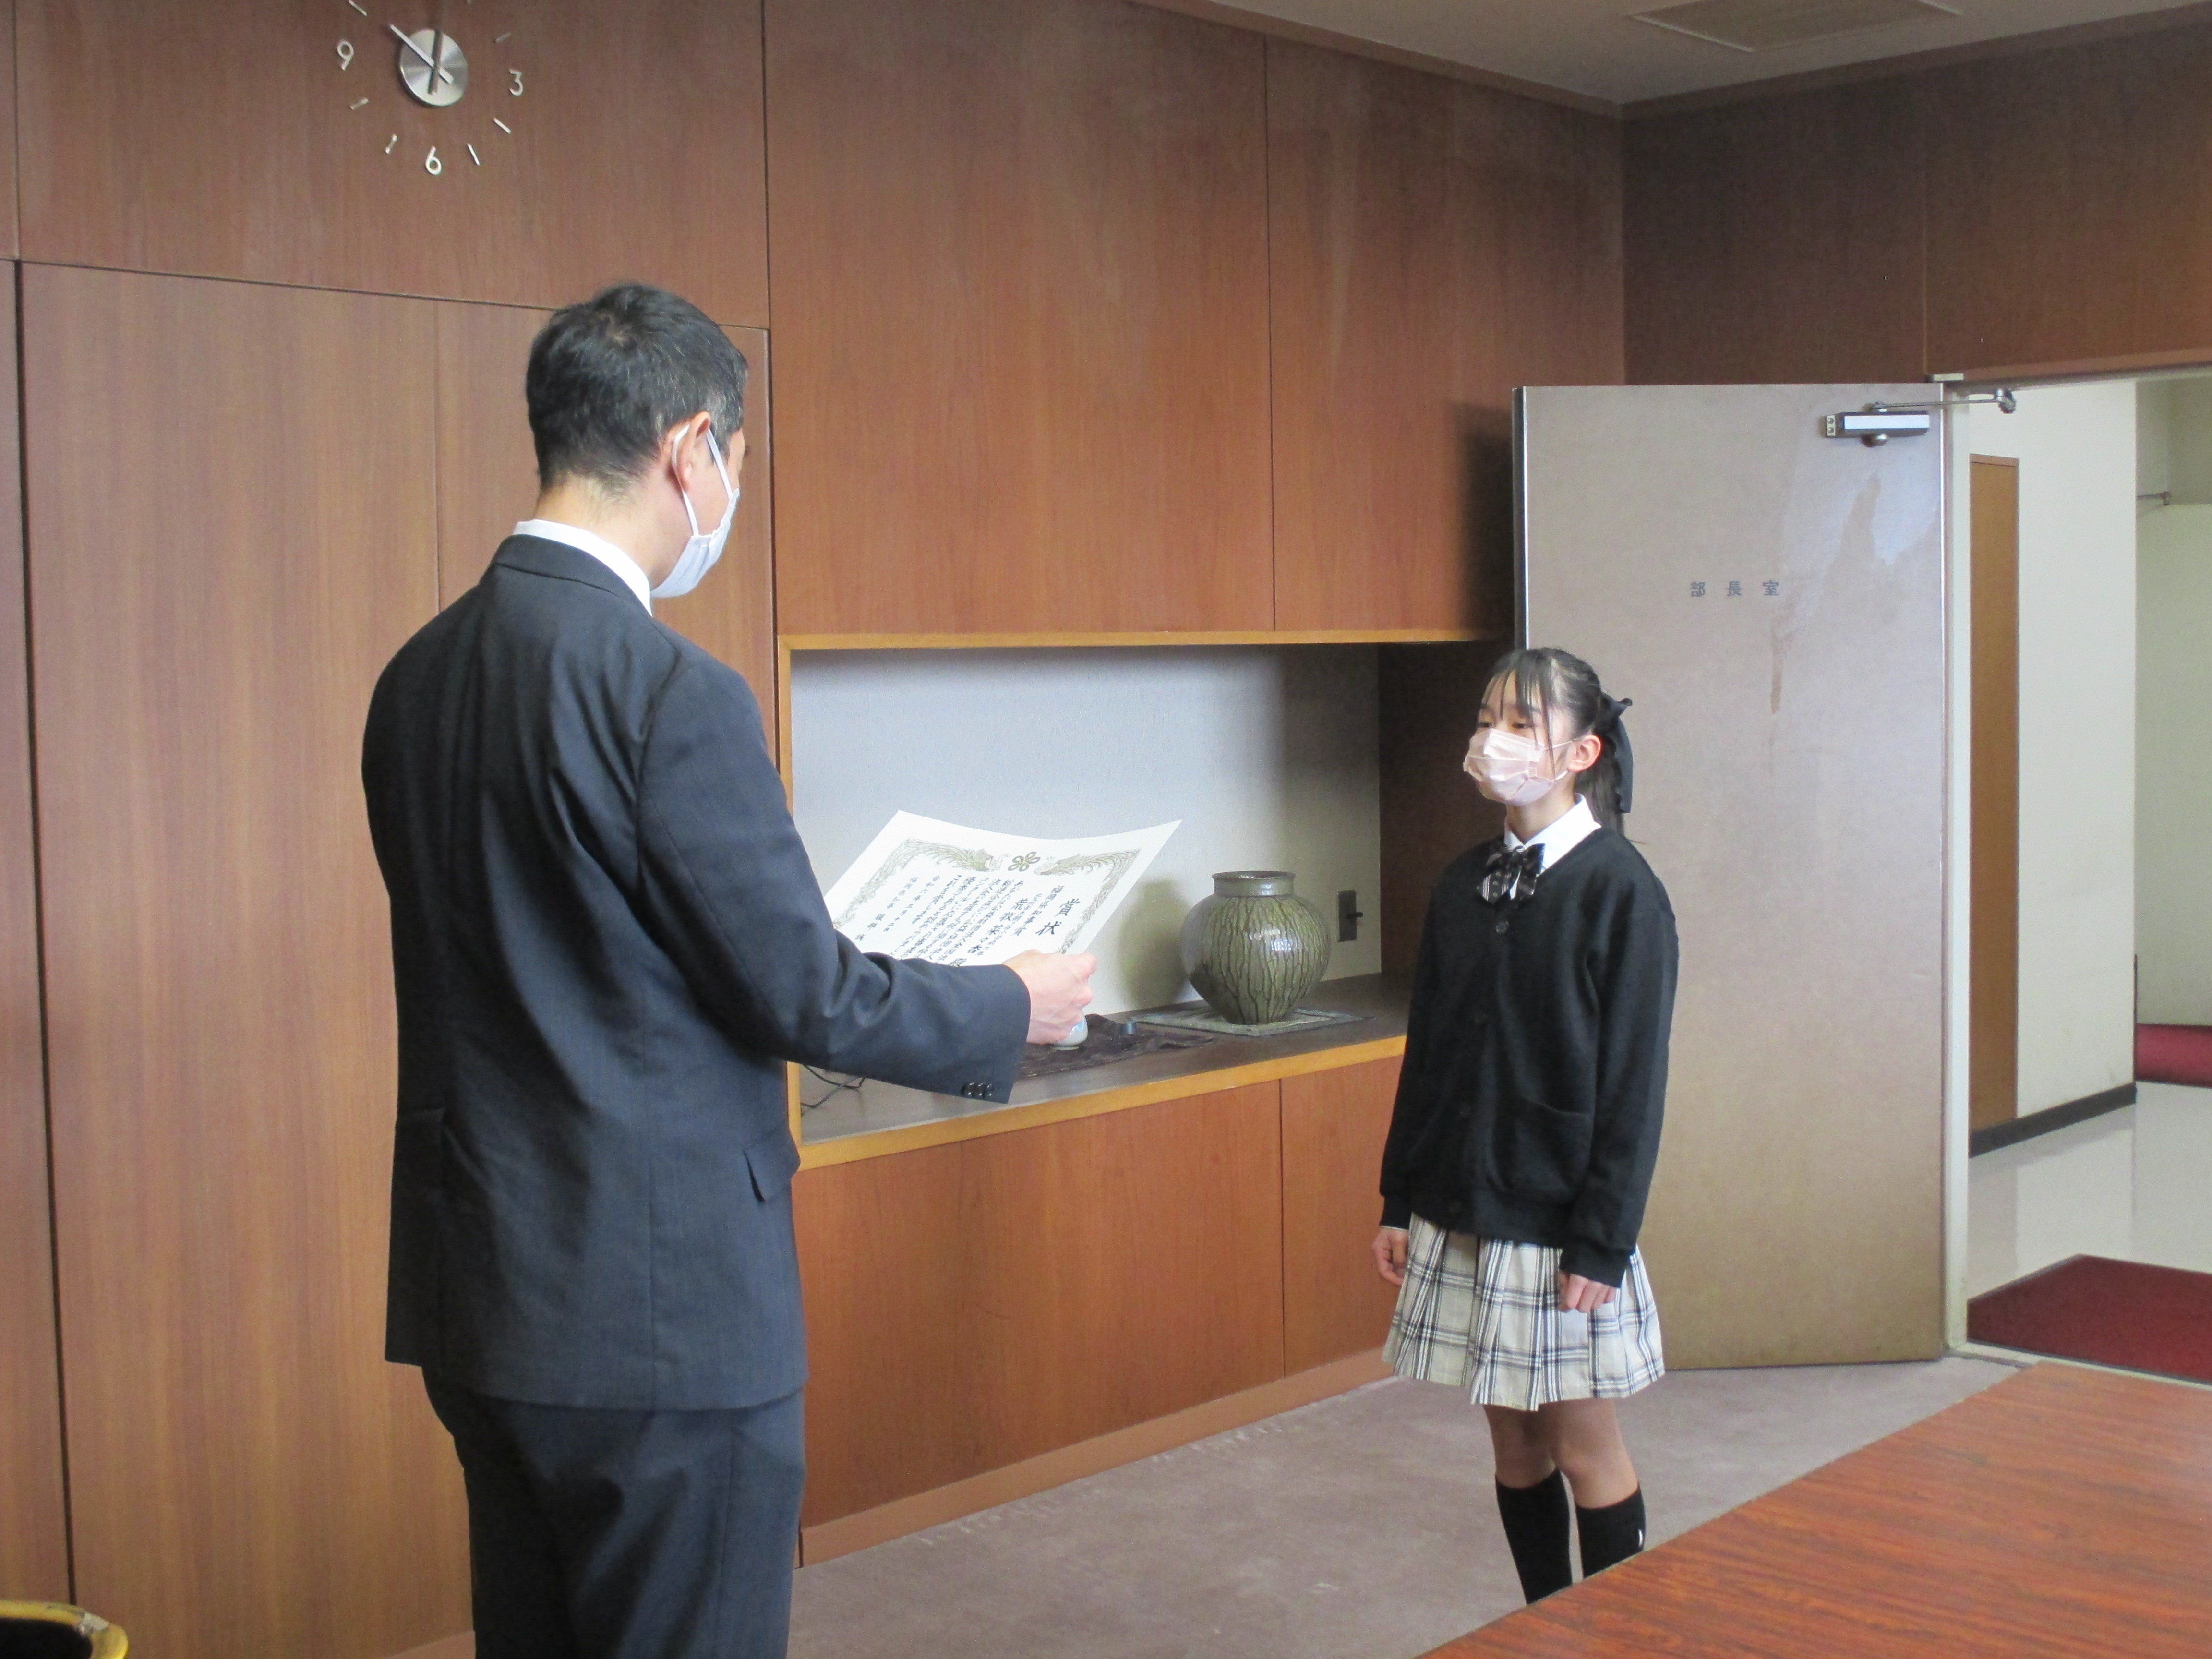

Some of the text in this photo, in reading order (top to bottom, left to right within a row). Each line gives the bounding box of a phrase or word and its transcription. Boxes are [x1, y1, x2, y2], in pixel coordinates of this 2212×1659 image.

[337, 40, 354, 70] 9
[509, 69, 523, 96] 3
[426, 146, 442, 175] 6
[1690, 580, 1779, 597] 部長室
[900, 878, 989, 959] コンクール」に応募され審査の
[1014, 885, 1064, 936] 福岡県知事賞
[1035, 899, 1080, 936] 賞状
[854, 914, 886, 942] 服部誠
